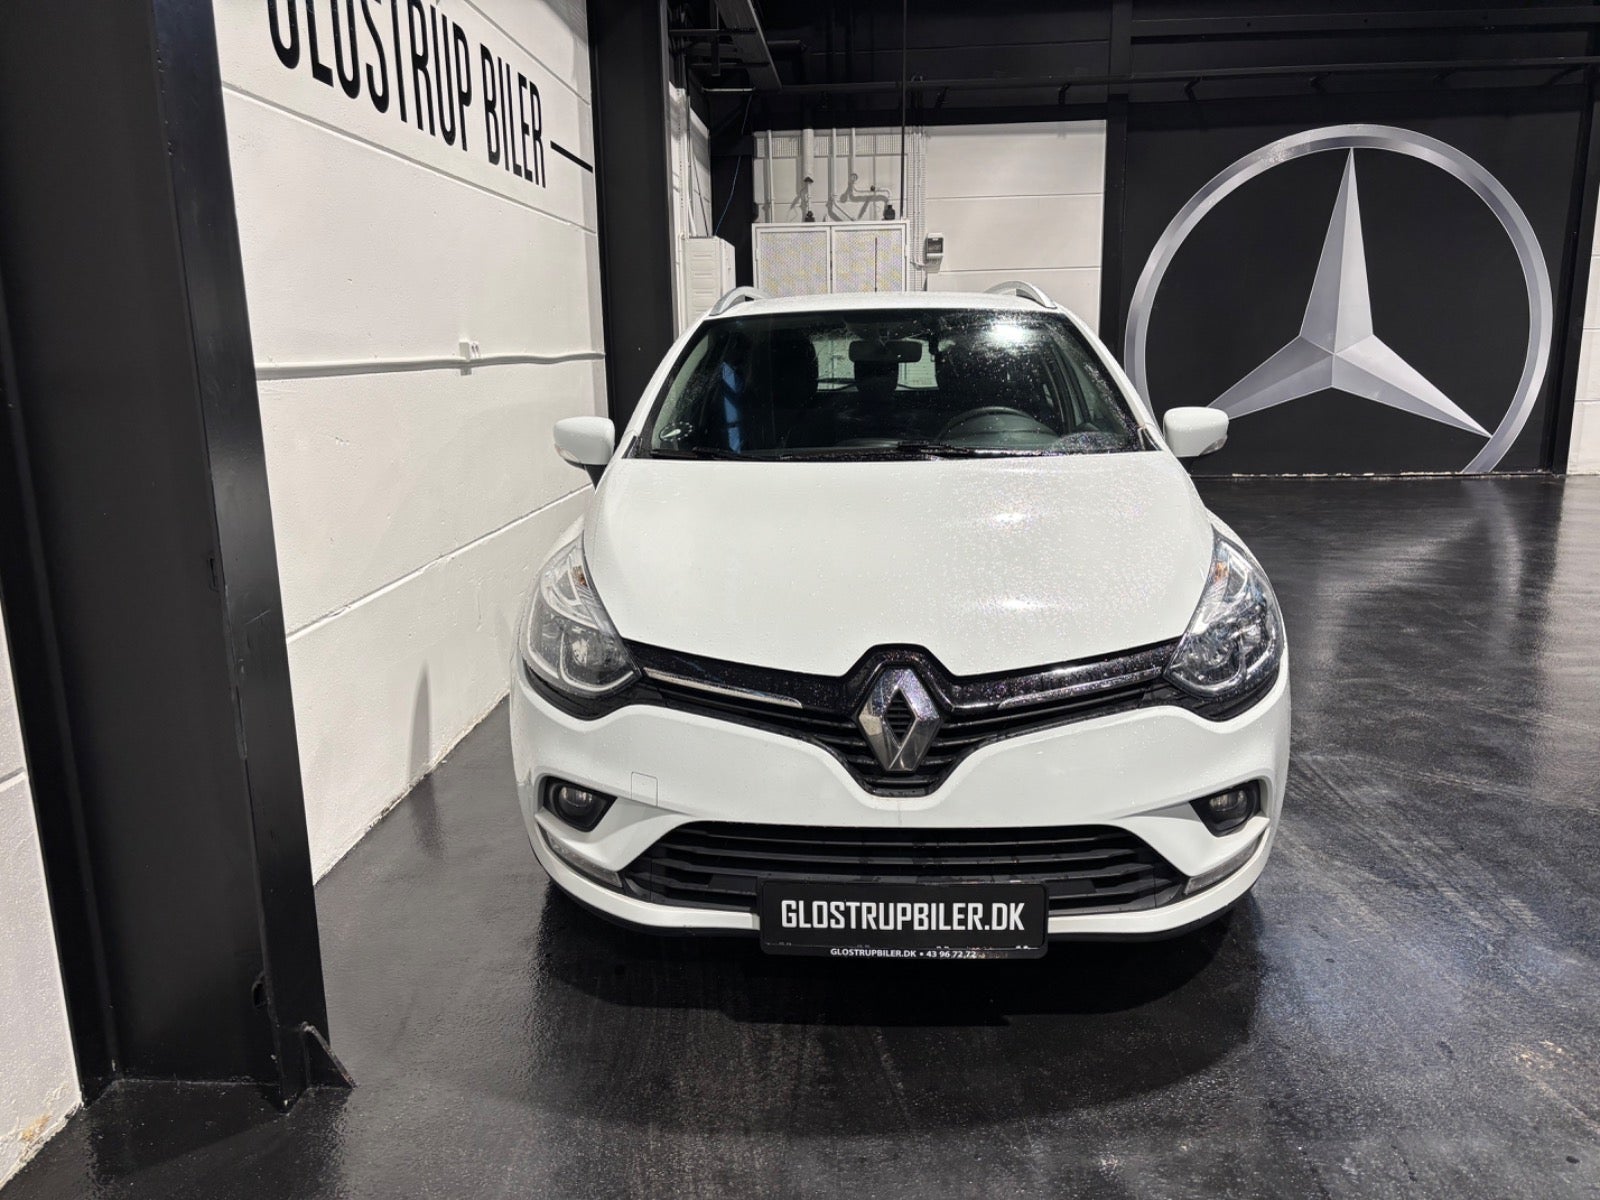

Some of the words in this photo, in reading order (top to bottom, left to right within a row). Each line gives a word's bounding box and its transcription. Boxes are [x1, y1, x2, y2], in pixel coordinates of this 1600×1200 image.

[480, 43, 546, 188] BILER
[781, 900, 1025, 931] GLOSTRUPBILER.DK
[830, 948, 917, 958] GLOSTRUPBILER.DK
[926, 950, 937, 958] 43
